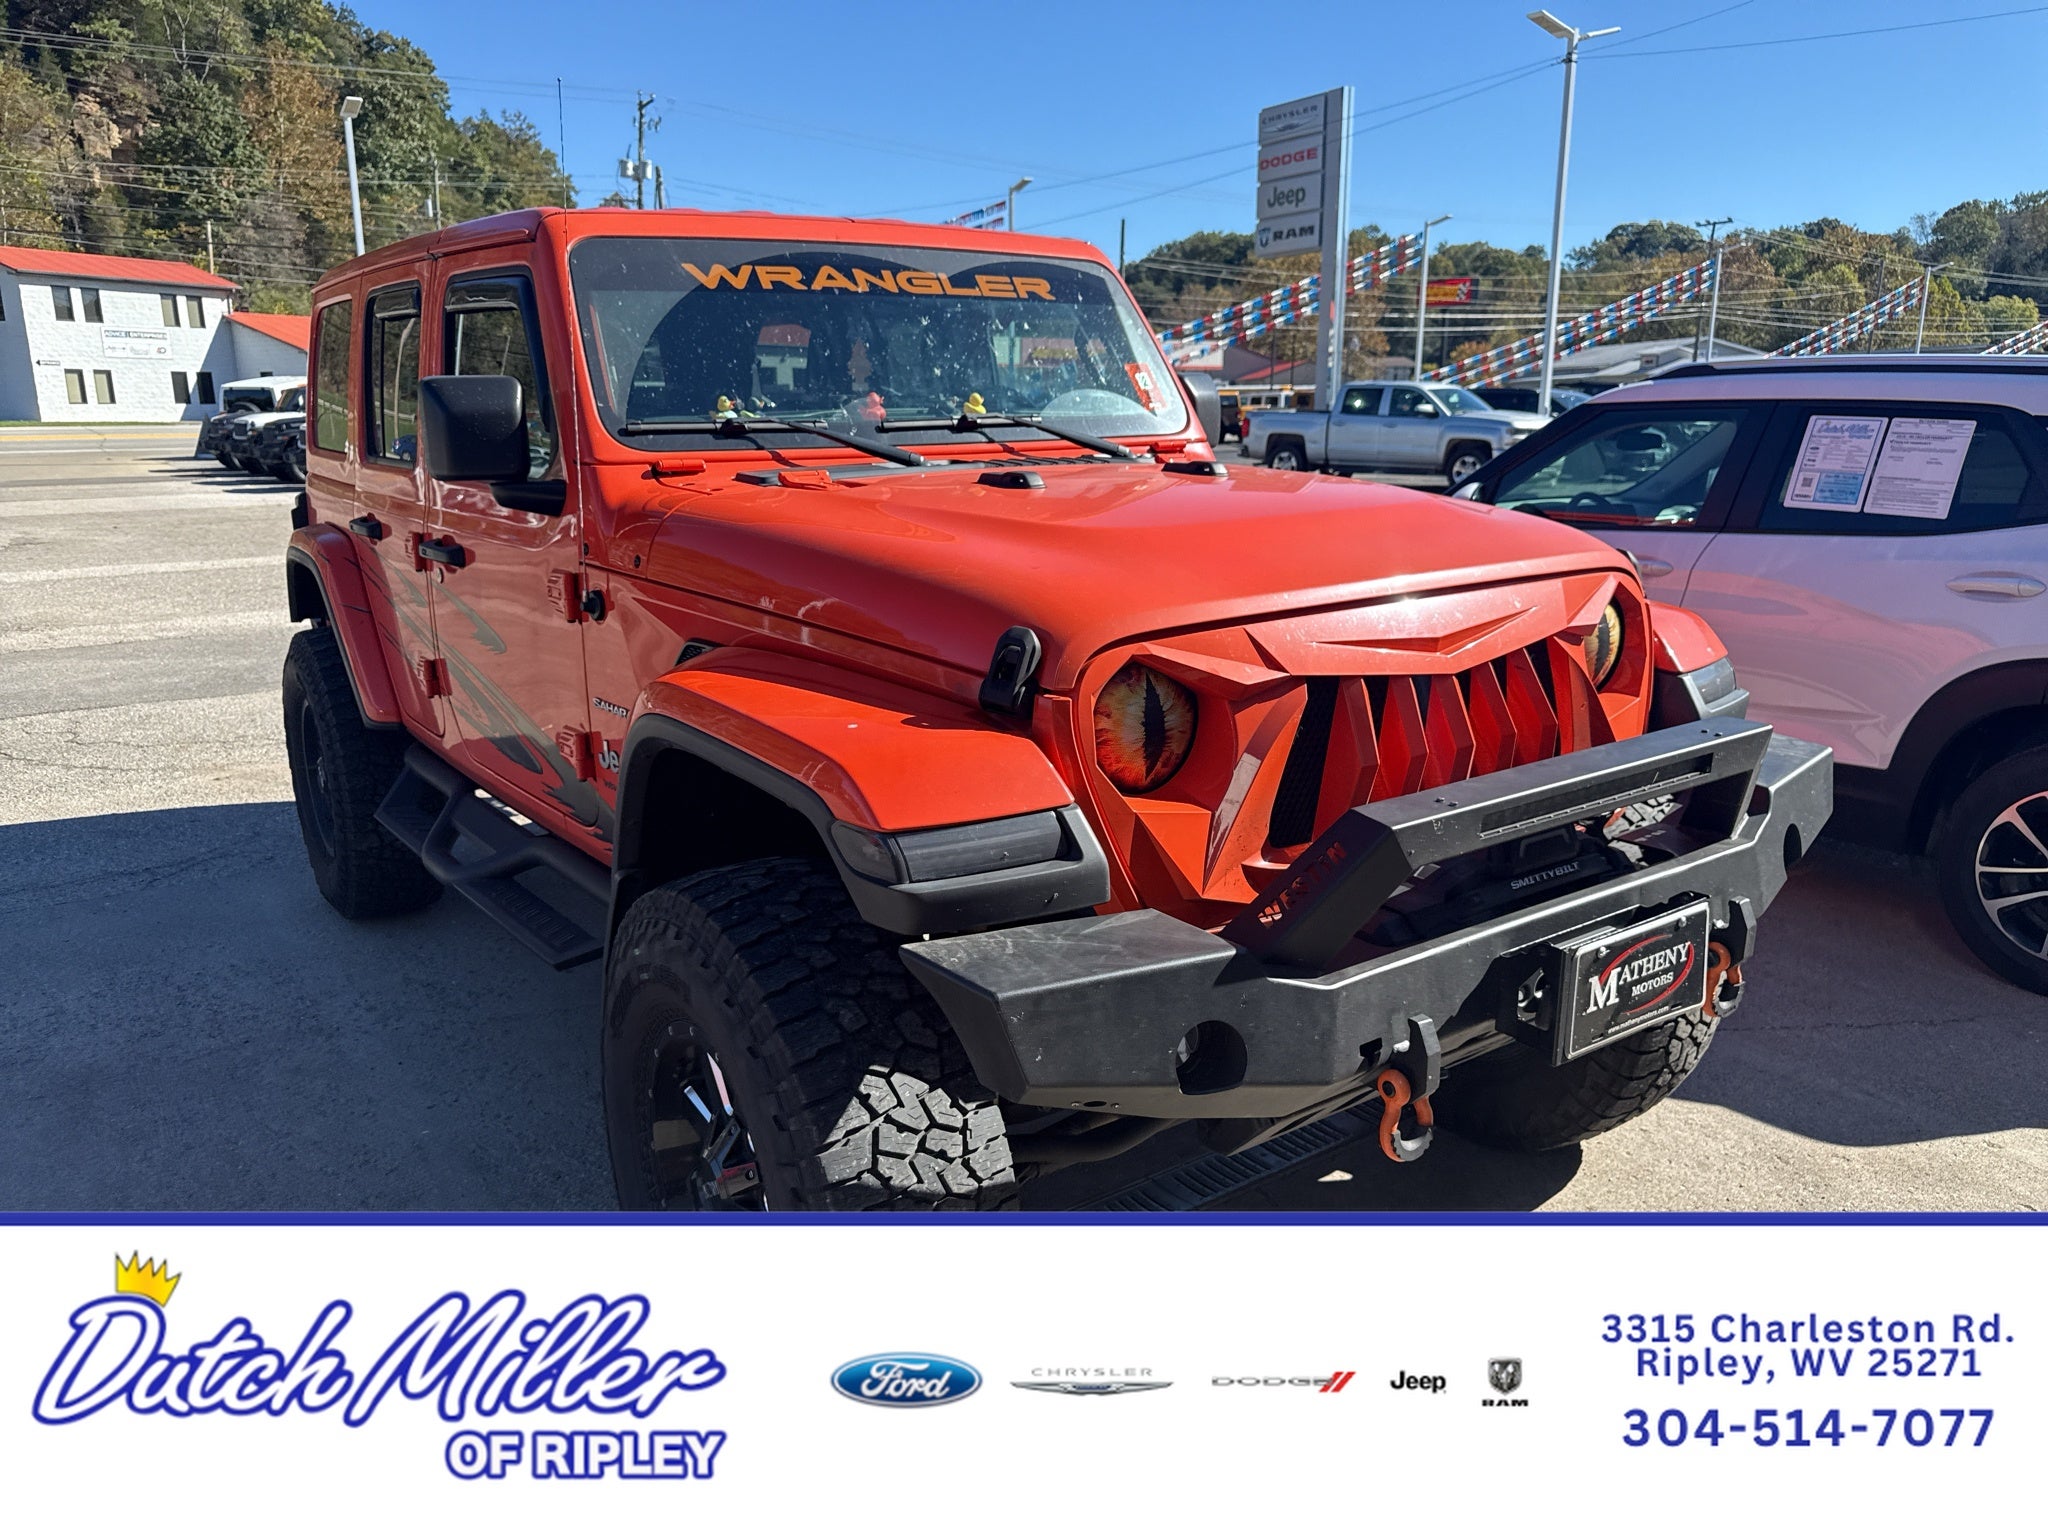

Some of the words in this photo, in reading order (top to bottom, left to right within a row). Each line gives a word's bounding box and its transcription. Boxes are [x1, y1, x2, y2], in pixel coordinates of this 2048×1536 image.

[1261, 105, 1318, 125] CHRYSLER
[1259, 148, 1318, 170] DODGE
[1267, 186, 1306, 208] Jeep
[1273, 225, 1314, 241] RAM
[681, 263, 1056, 300] WRANGLER
[593, 696, 630, 719] SAHAR
[1510, 861, 1580, 890] SMITTYBILT
[1583, 942, 1691, 1015] MATHENY
[1631, 972, 1674, 997] MOTORS
